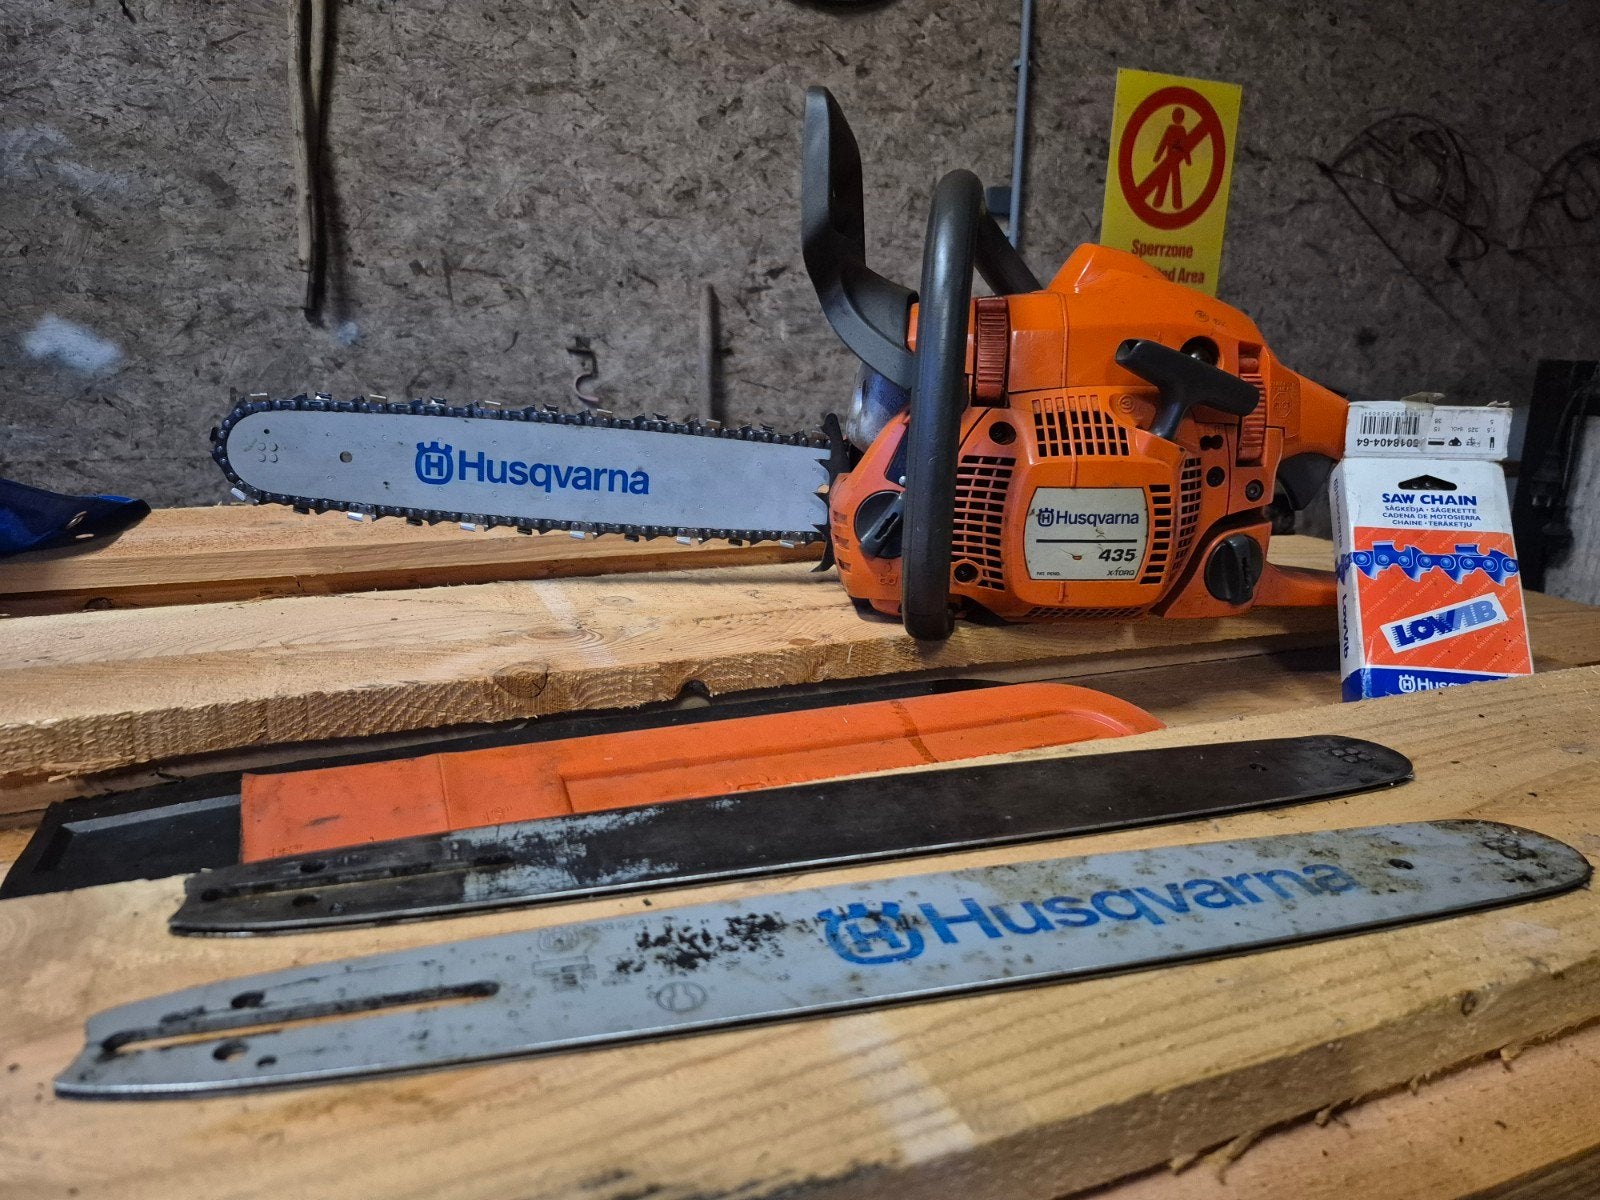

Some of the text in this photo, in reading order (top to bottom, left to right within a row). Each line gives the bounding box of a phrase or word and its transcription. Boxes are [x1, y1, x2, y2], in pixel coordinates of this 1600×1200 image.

[1132, 239, 1194, 259] Sperrzone
[1178, 267, 1205, 284] Area
[458, 449, 650, 495] Husqvarna
[1382, 493, 1477, 506] SAW CHAIN
[1056, 510, 1139, 528] Husqvarna
[1098, 548, 1137, 562] 435
[917, 863, 1356, 944] Husqvarna
